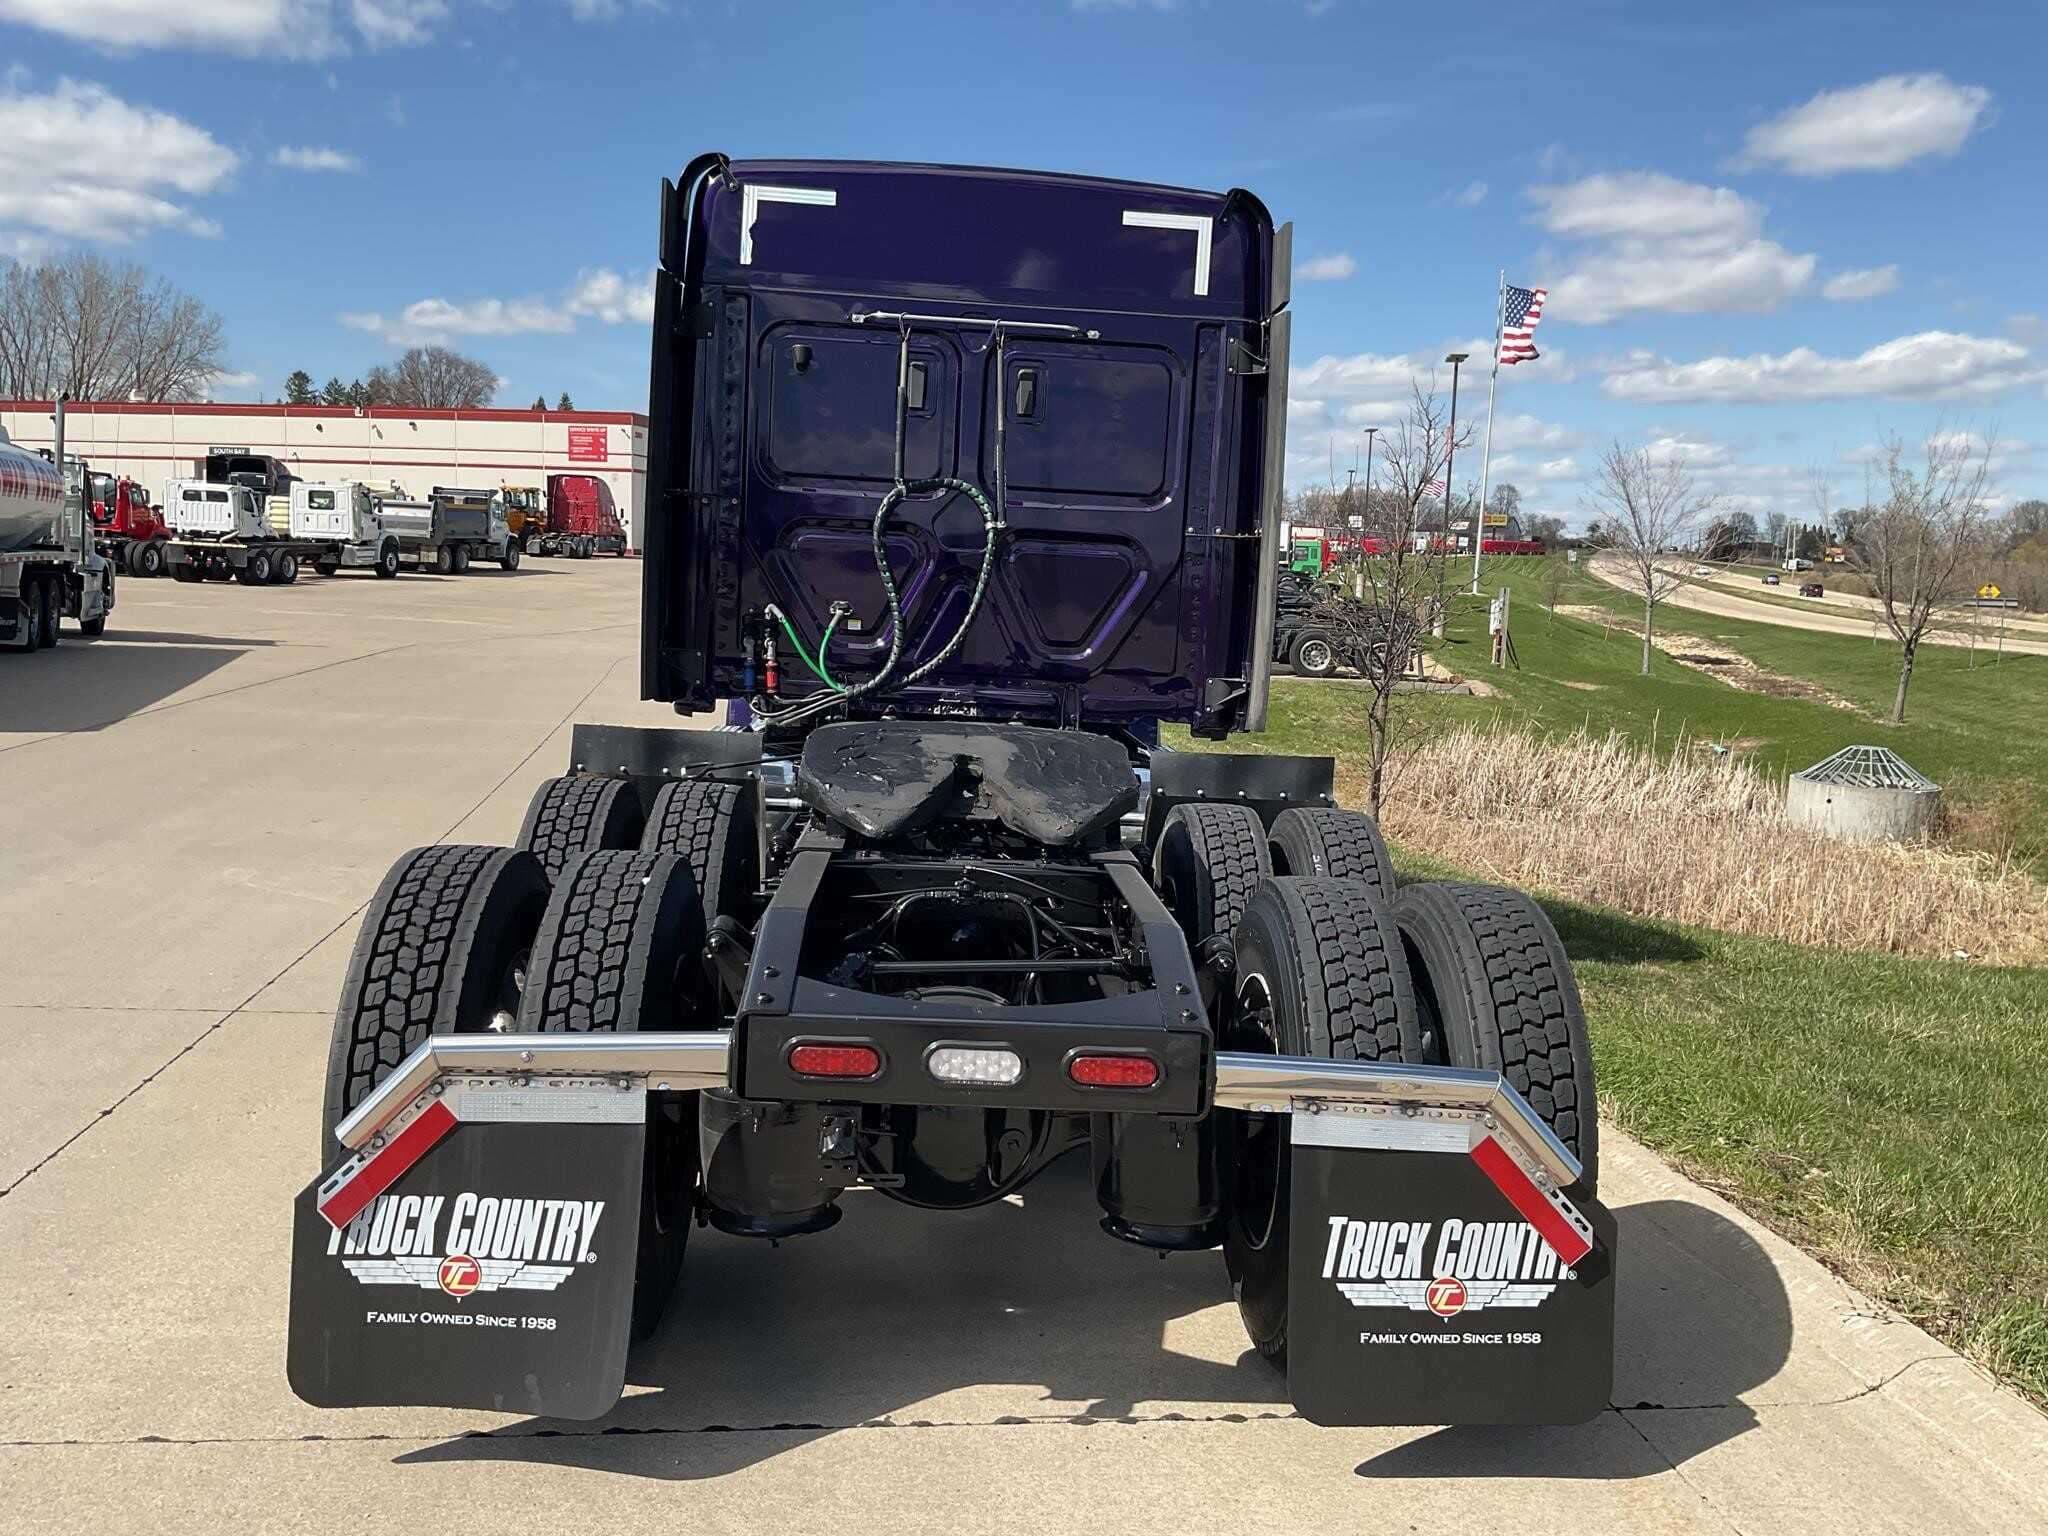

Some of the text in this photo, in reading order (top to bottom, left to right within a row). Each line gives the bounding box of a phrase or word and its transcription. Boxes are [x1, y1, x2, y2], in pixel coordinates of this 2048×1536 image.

[446, 1192, 605, 1262] COUNTRY
[1322, 1216, 1432, 1279] TRUCK
[366, 1311, 557, 1331] FAMILY OWNED SINCE 1958
[1360, 1332, 1542, 1344] FAMILY OWNED SINCE 1958
